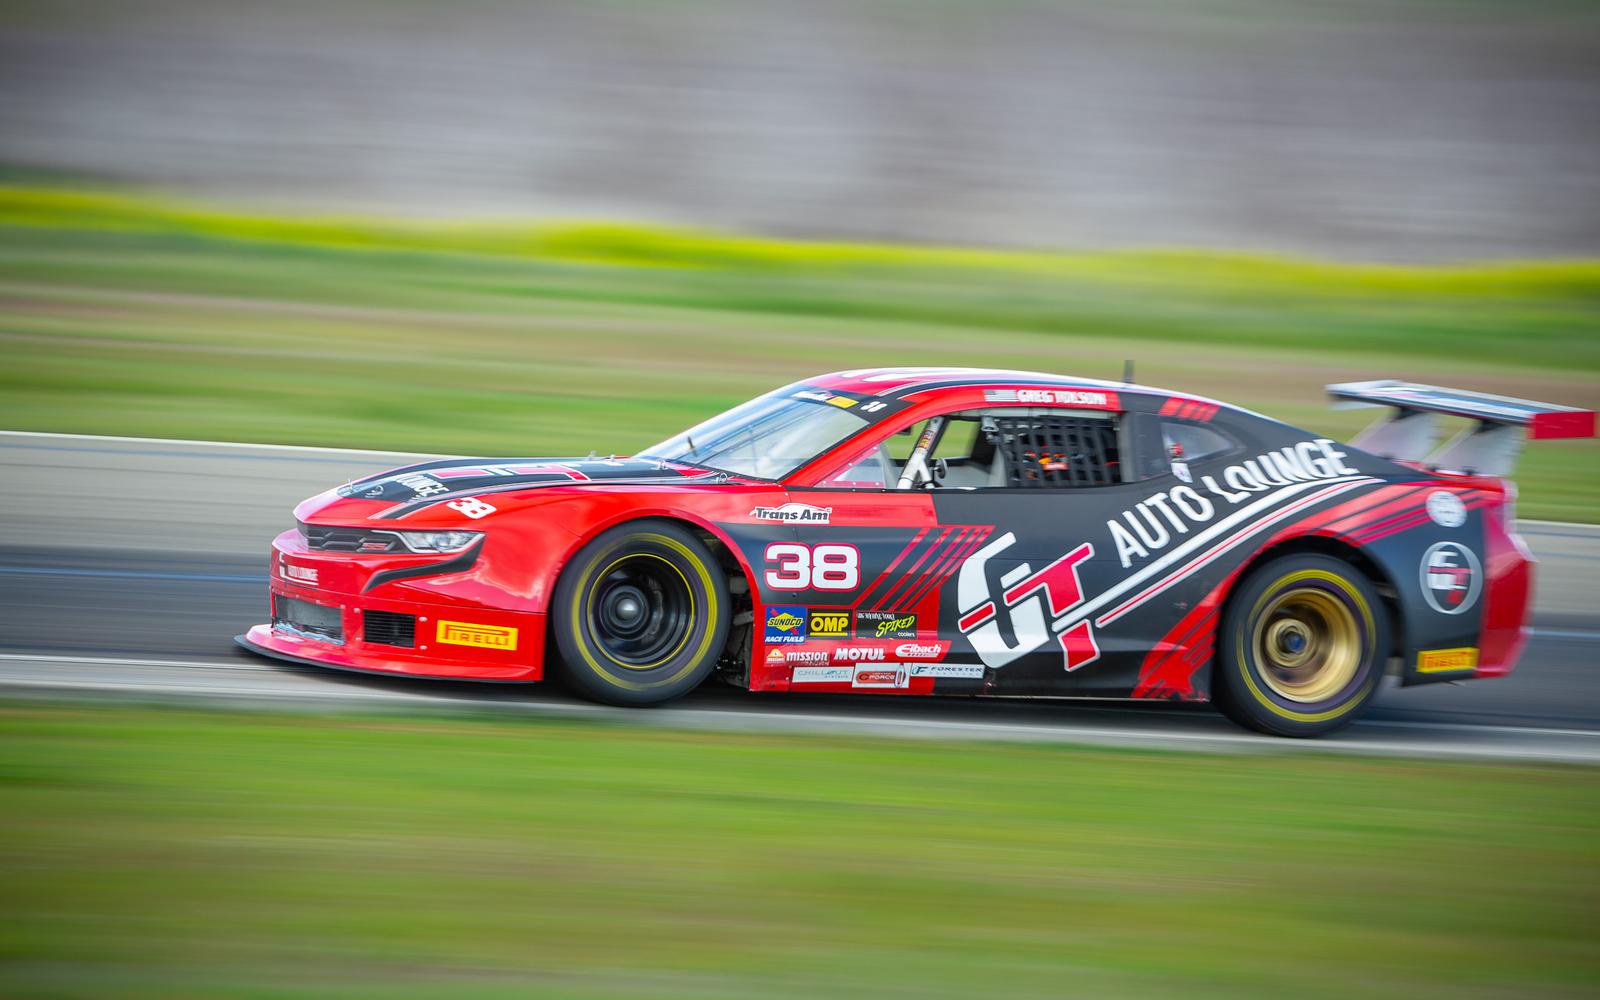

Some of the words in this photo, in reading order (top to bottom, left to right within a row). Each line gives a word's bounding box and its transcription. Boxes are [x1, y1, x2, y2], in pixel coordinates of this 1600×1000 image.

[447, 497, 496, 519] 38
[1107, 485, 1215, 568] AUTO
[1201, 439, 1360, 504] LOUNGE
[756, 508, 797, 519] Trans
[800, 509, 828, 520] Am
[764, 542, 858, 590] 38
[957, 532, 1101, 672] GT
[768, 618, 802, 626] SUNOCO
[811, 617, 848, 632] OMP
[875, 615, 915, 638] SPIKED
[445, 624, 509, 645] PIRELLI
[786, 651, 829, 662] mission
[834, 648, 885, 661] MOTUL
[895, 644, 941, 657] Eibach
